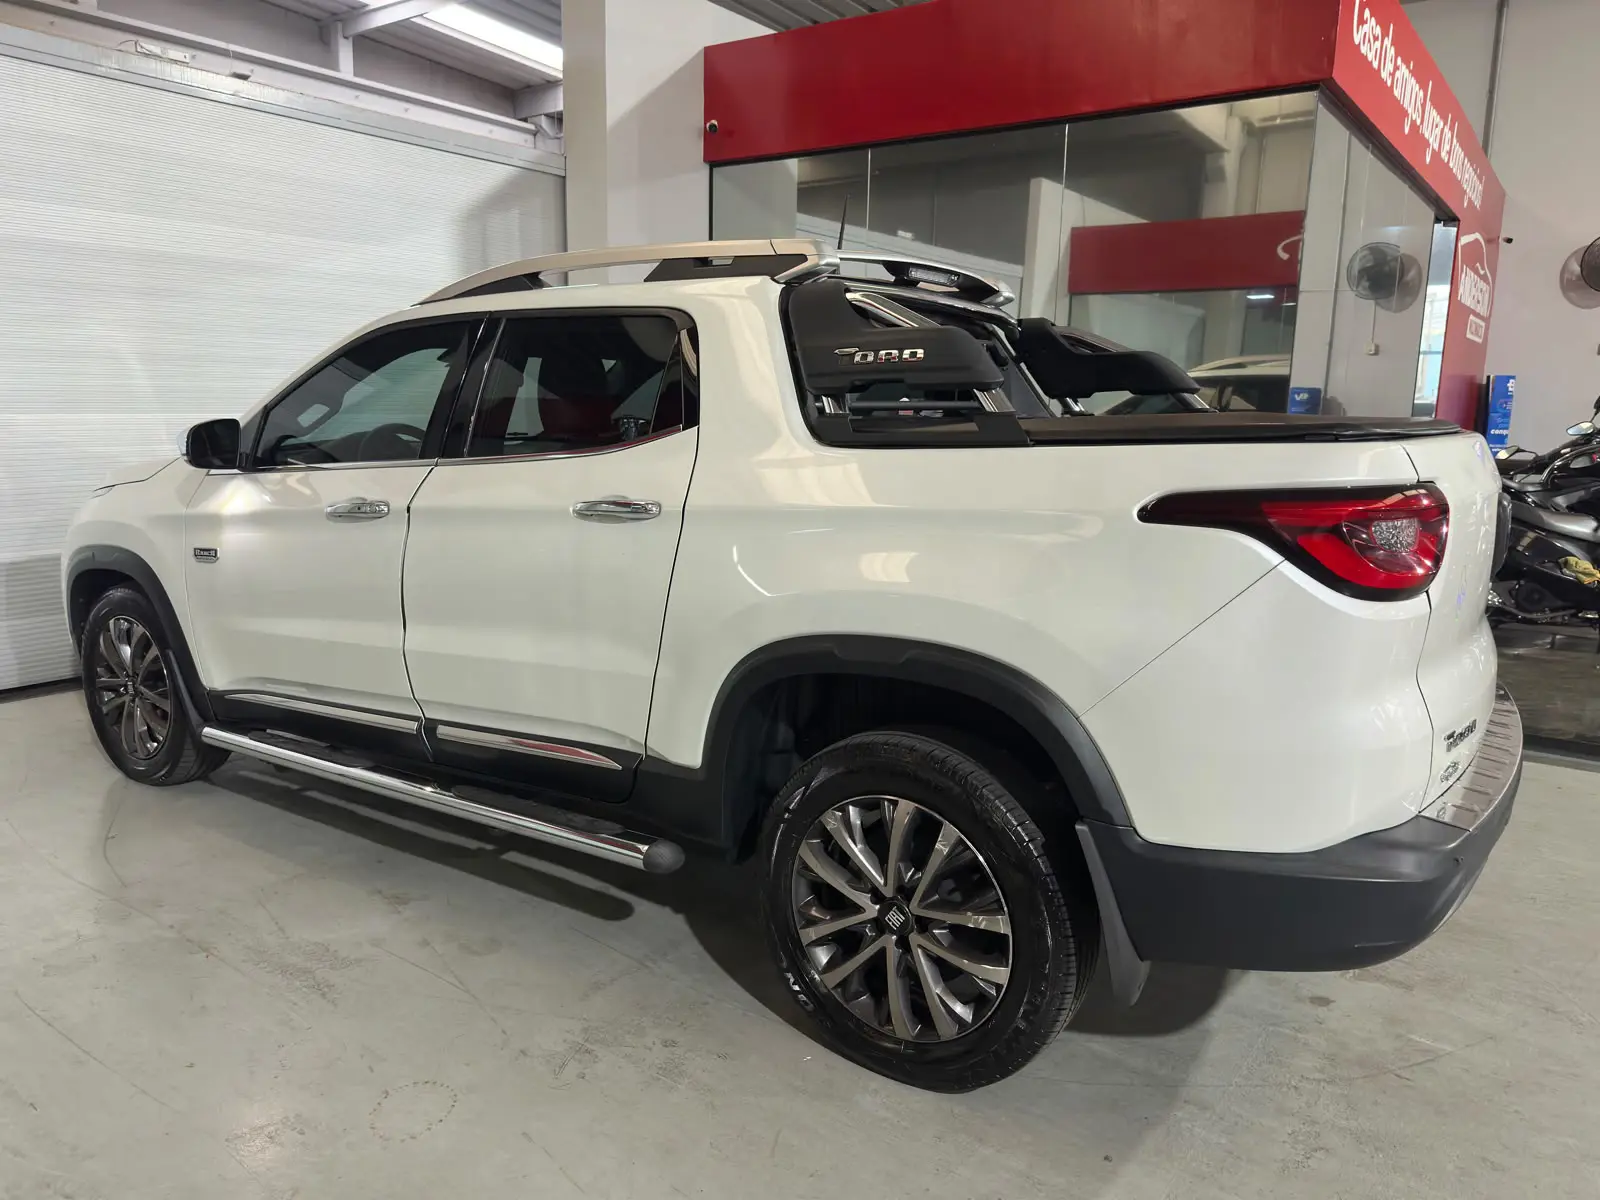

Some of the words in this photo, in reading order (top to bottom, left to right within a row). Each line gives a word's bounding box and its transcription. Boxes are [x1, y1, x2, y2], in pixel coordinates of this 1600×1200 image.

[1353, 0, 1381, 71] Casa
[1381, 23, 1395, 87] de
[1422, 80, 1444, 165] lugar
[1440, 113, 1452, 163] de
[1449, 121, 1464, 181] bons
[885, 905, 905, 930] FIAT
